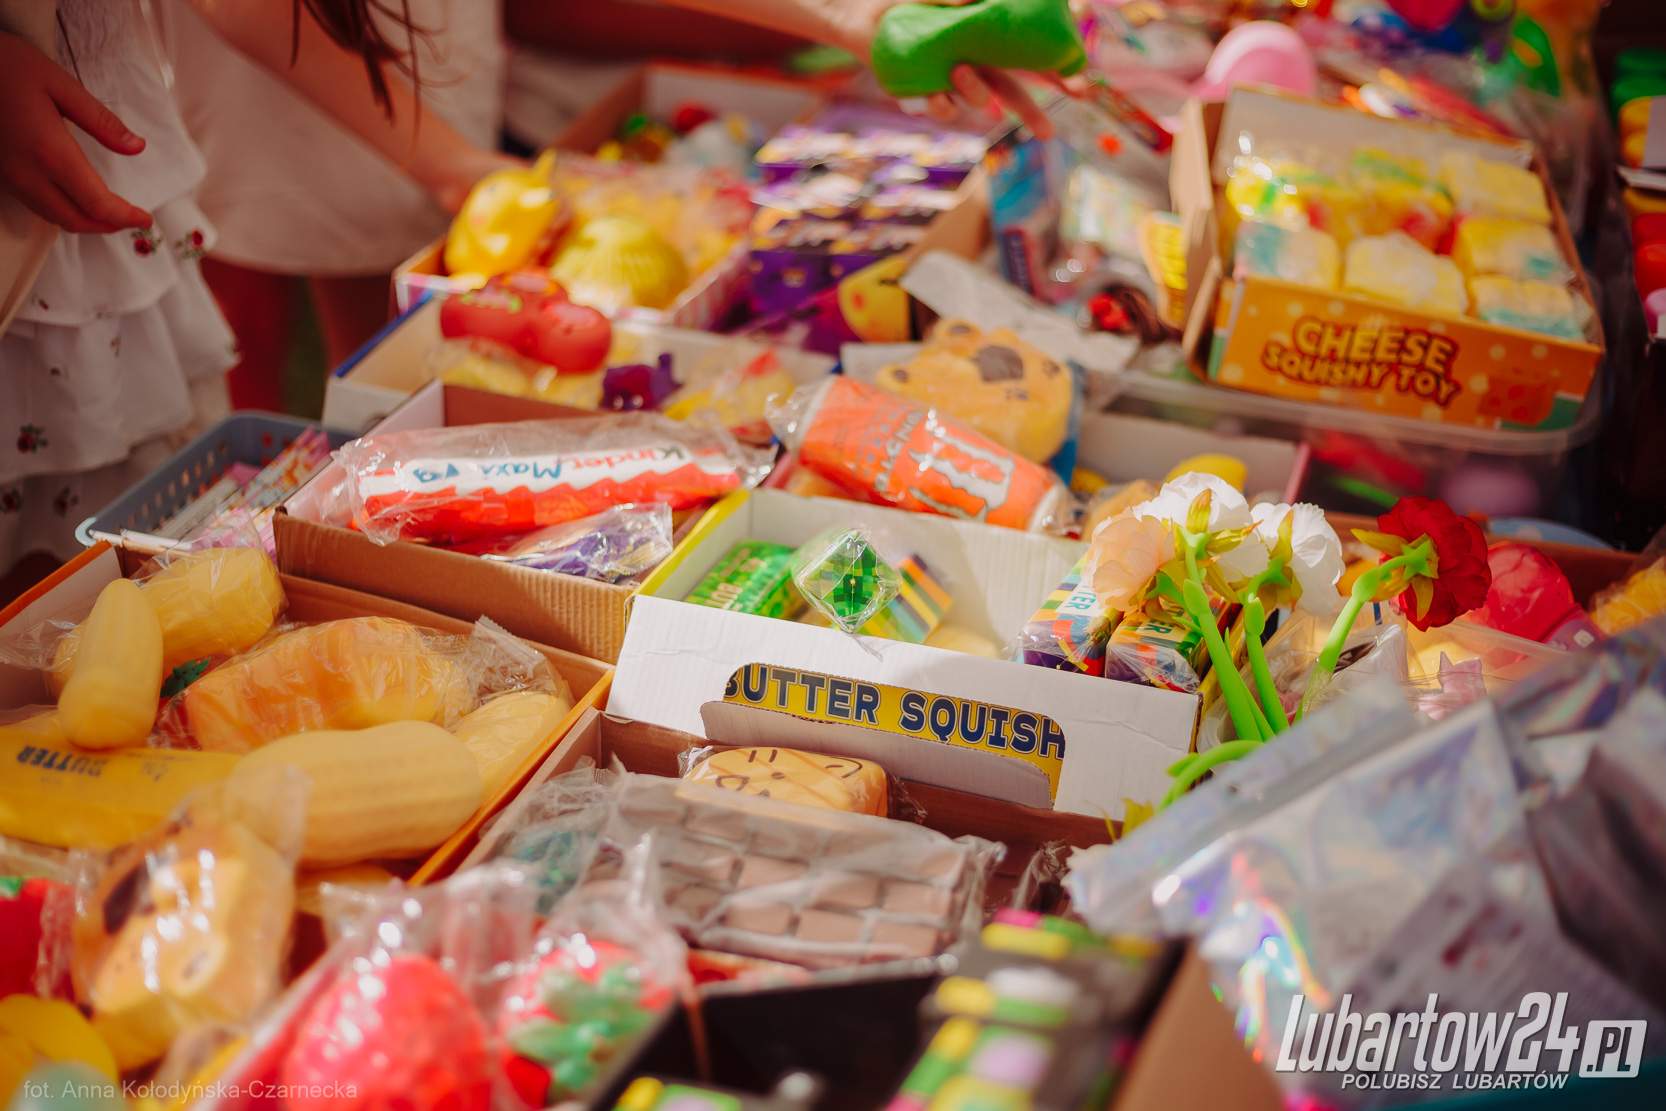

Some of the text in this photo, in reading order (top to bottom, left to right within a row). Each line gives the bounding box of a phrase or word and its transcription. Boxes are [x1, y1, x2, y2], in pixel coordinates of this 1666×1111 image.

[1263, 344, 1460, 402] SQUISHY TOY
[1296, 319, 1453, 374] CHEESE
[480, 444, 685, 480] Kinder Maxi
[898, 690, 1066, 760] SQUISH
